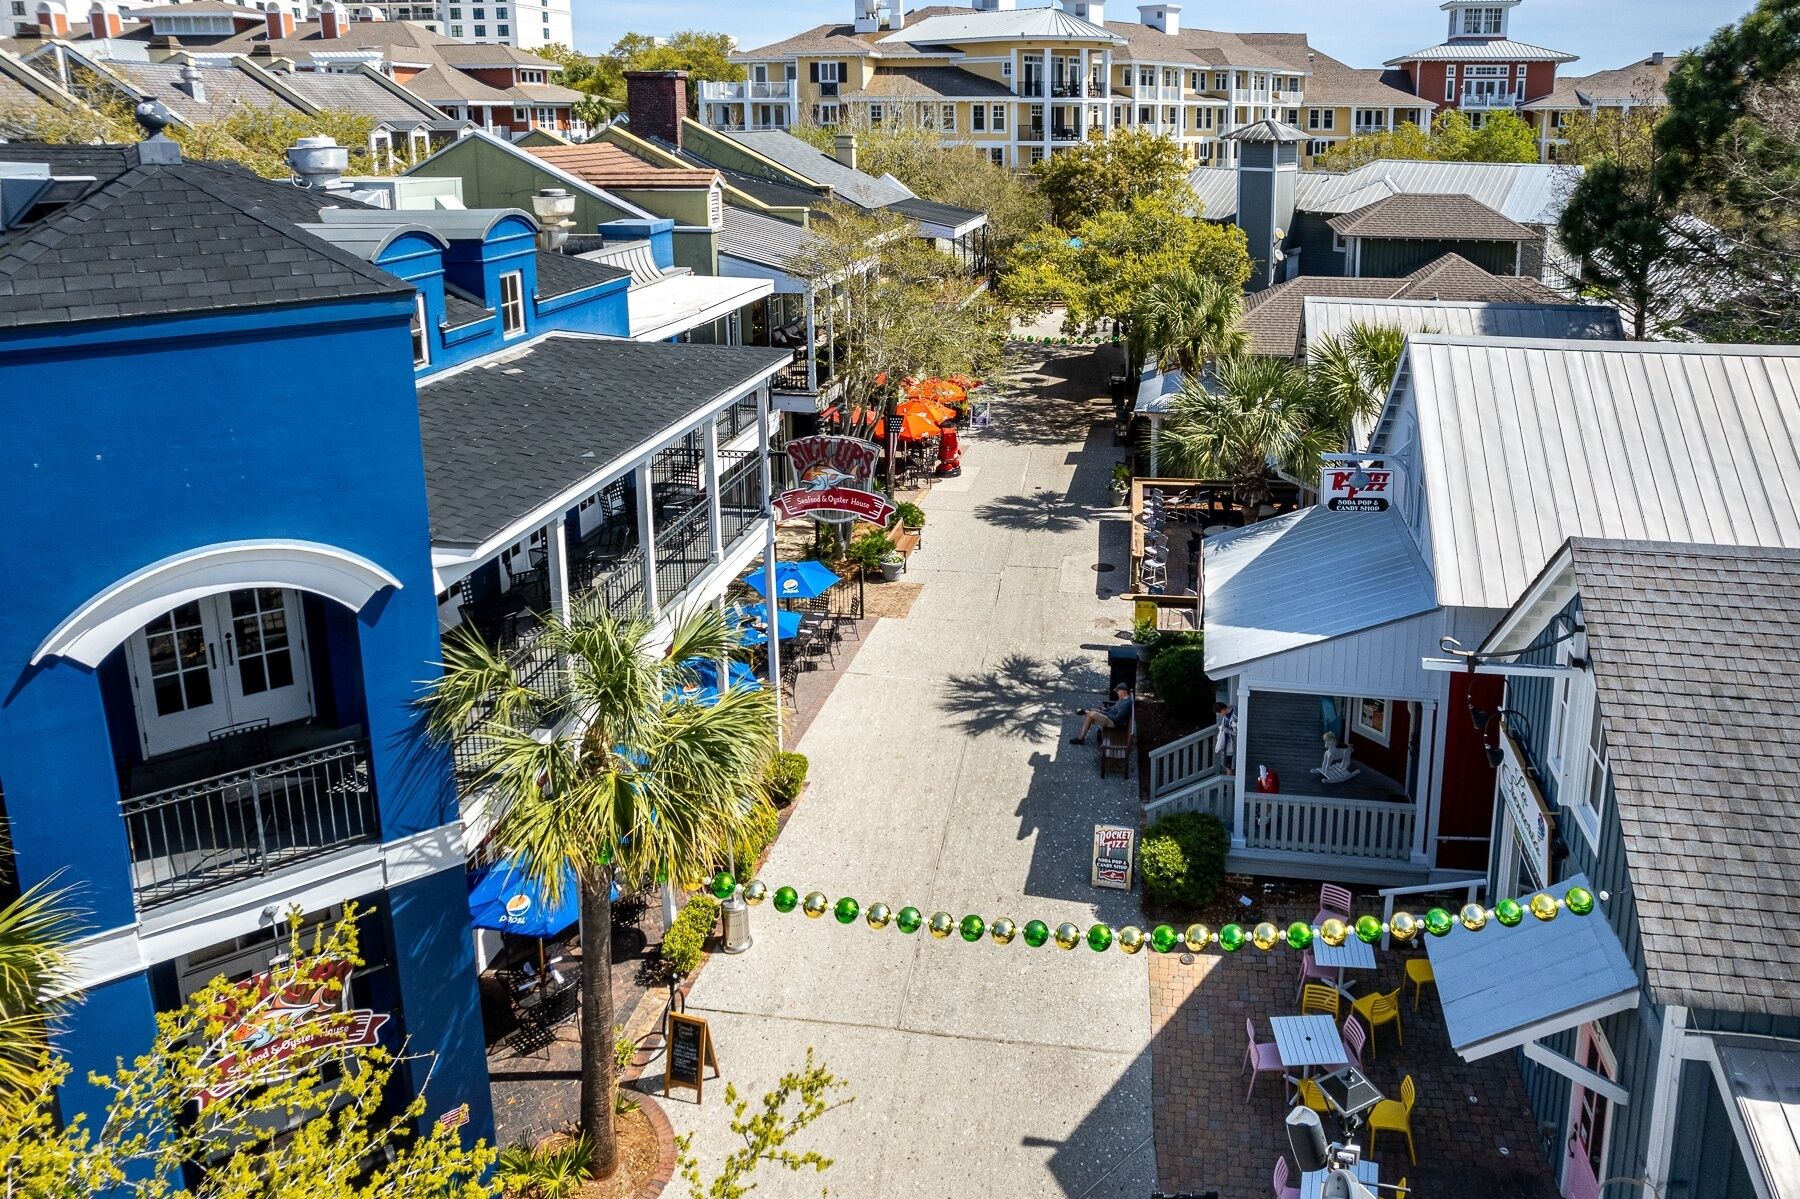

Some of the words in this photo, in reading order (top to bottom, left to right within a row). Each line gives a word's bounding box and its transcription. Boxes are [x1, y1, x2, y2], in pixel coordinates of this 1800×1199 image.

[788, 437, 832, 472] SLICK
[796, 495, 821, 505] Seafood
[827, 494, 849, 506] Oyster
[850, 497, 870, 509] House
[1096, 831, 1131, 846] ROCKET
[1105, 841, 1128, 856] FIZZ
[281, 1034, 315, 1051] Oyster
